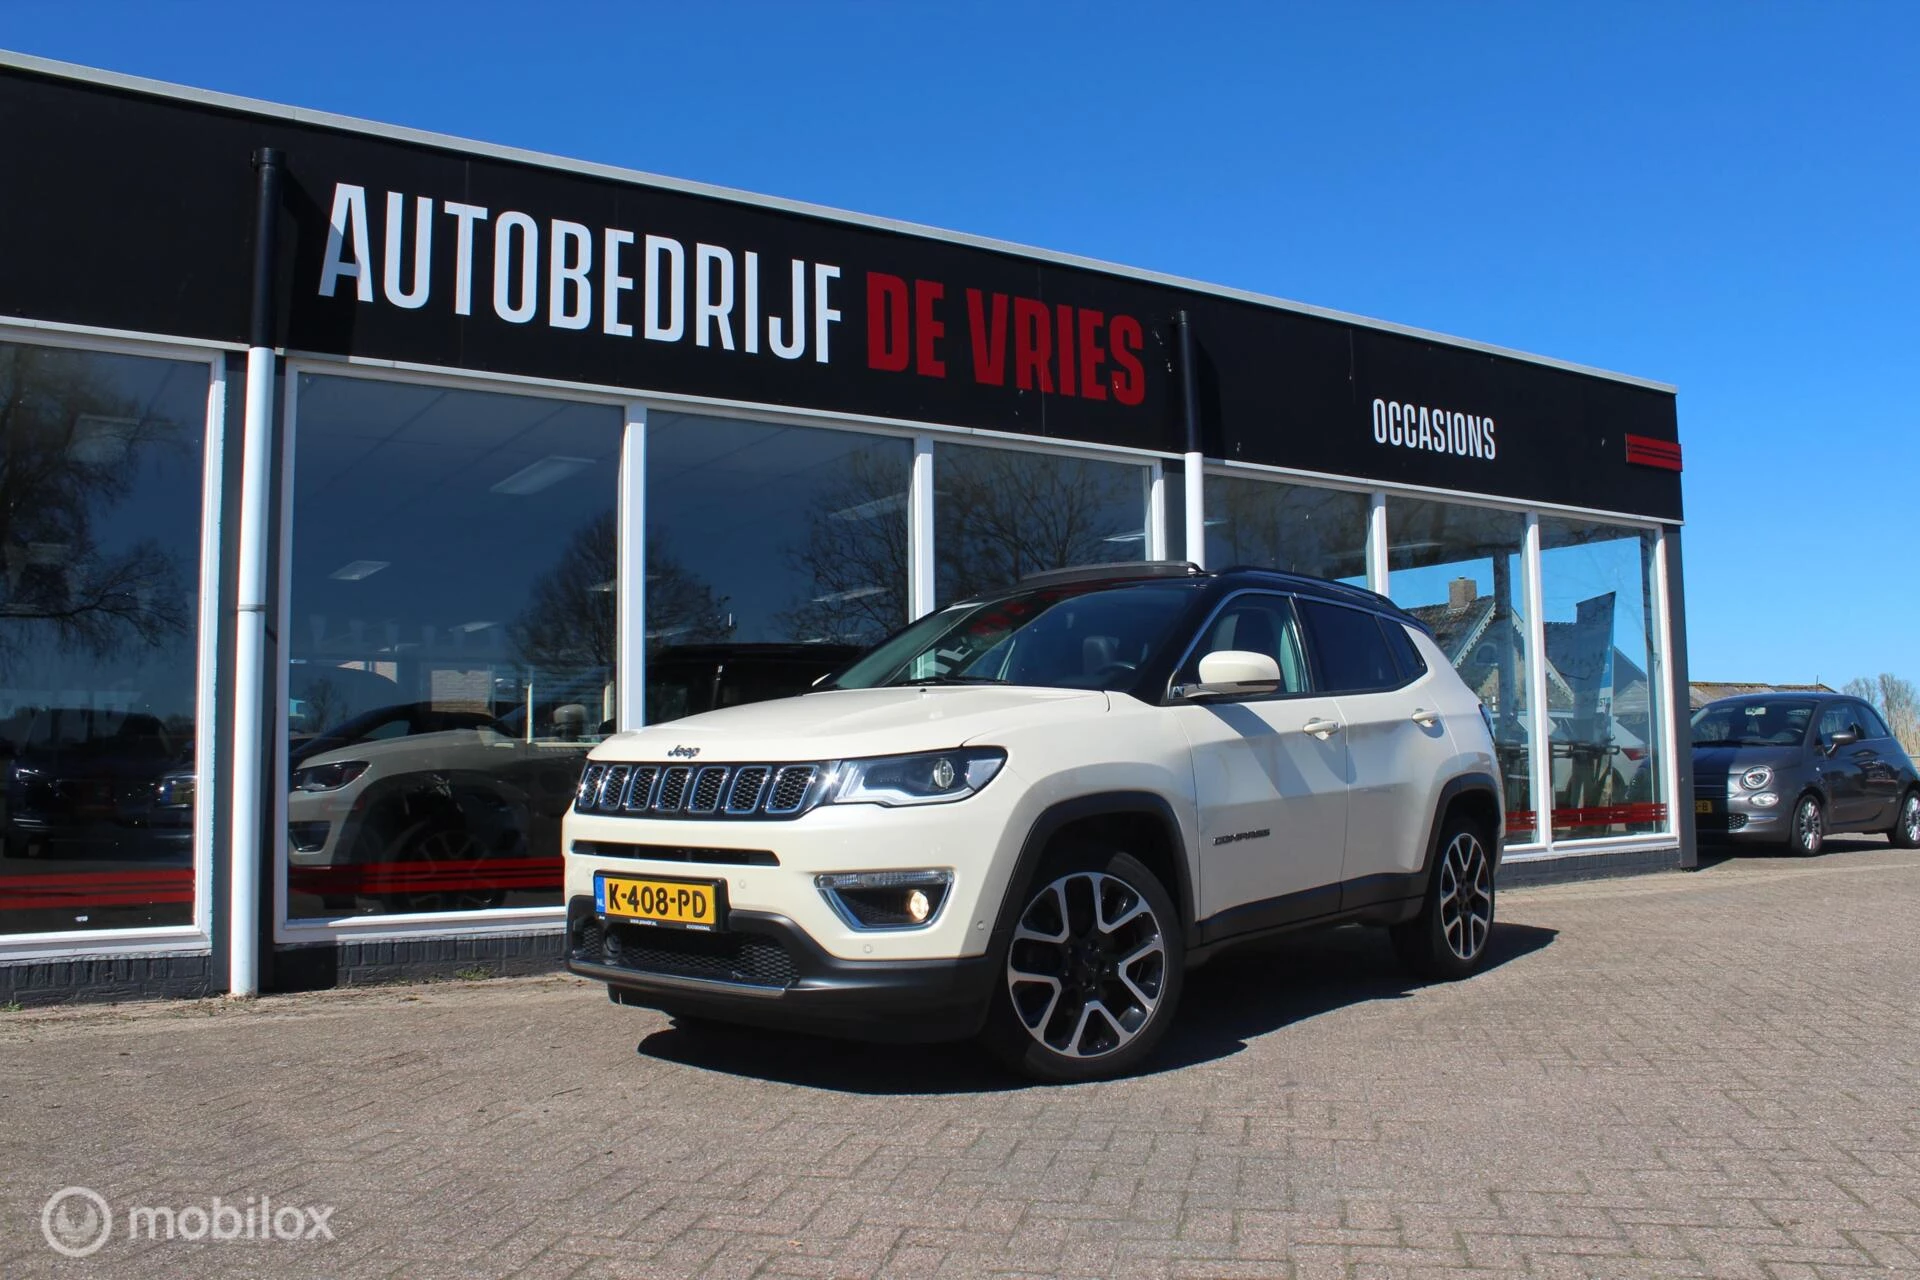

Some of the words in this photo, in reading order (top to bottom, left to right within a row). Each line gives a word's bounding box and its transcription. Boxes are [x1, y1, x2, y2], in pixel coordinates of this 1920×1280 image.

[318, 182, 841, 363] AUTOBEDRIJF
[866, 271, 946, 379] DE
[966, 287, 1145, 406] VRIES
[1373, 398, 1496, 460] OCCASIONS
[667, 744, 701, 759] Jeep
[608, 883, 707, 918] K-408-PD
